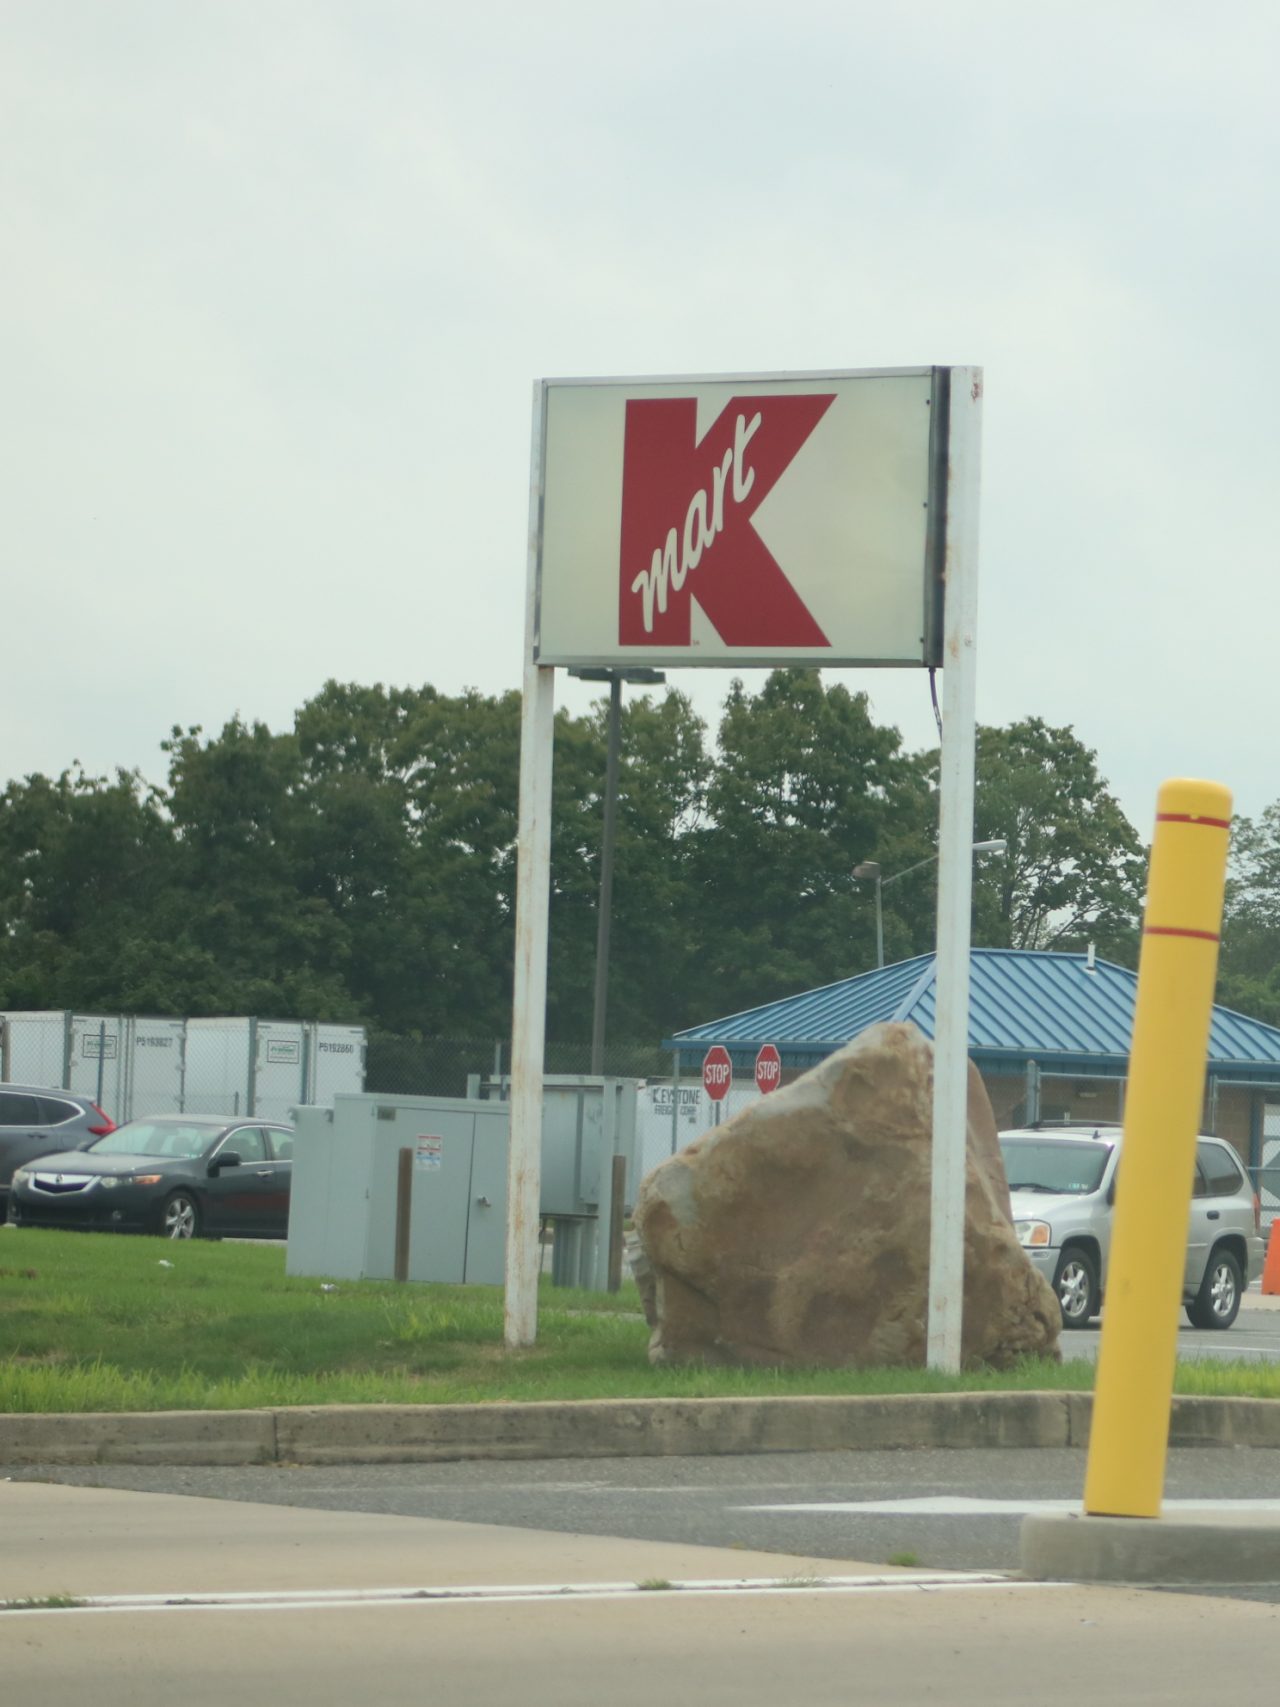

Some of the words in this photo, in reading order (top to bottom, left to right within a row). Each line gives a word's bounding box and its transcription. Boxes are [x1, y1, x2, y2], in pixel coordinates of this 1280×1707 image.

[631, 411, 761, 633] mart
[705, 1064, 729, 1084] STOP
[757, 1061, 778, 1080] STOP
[653, 1087, 700, 1104] KEYTONE
